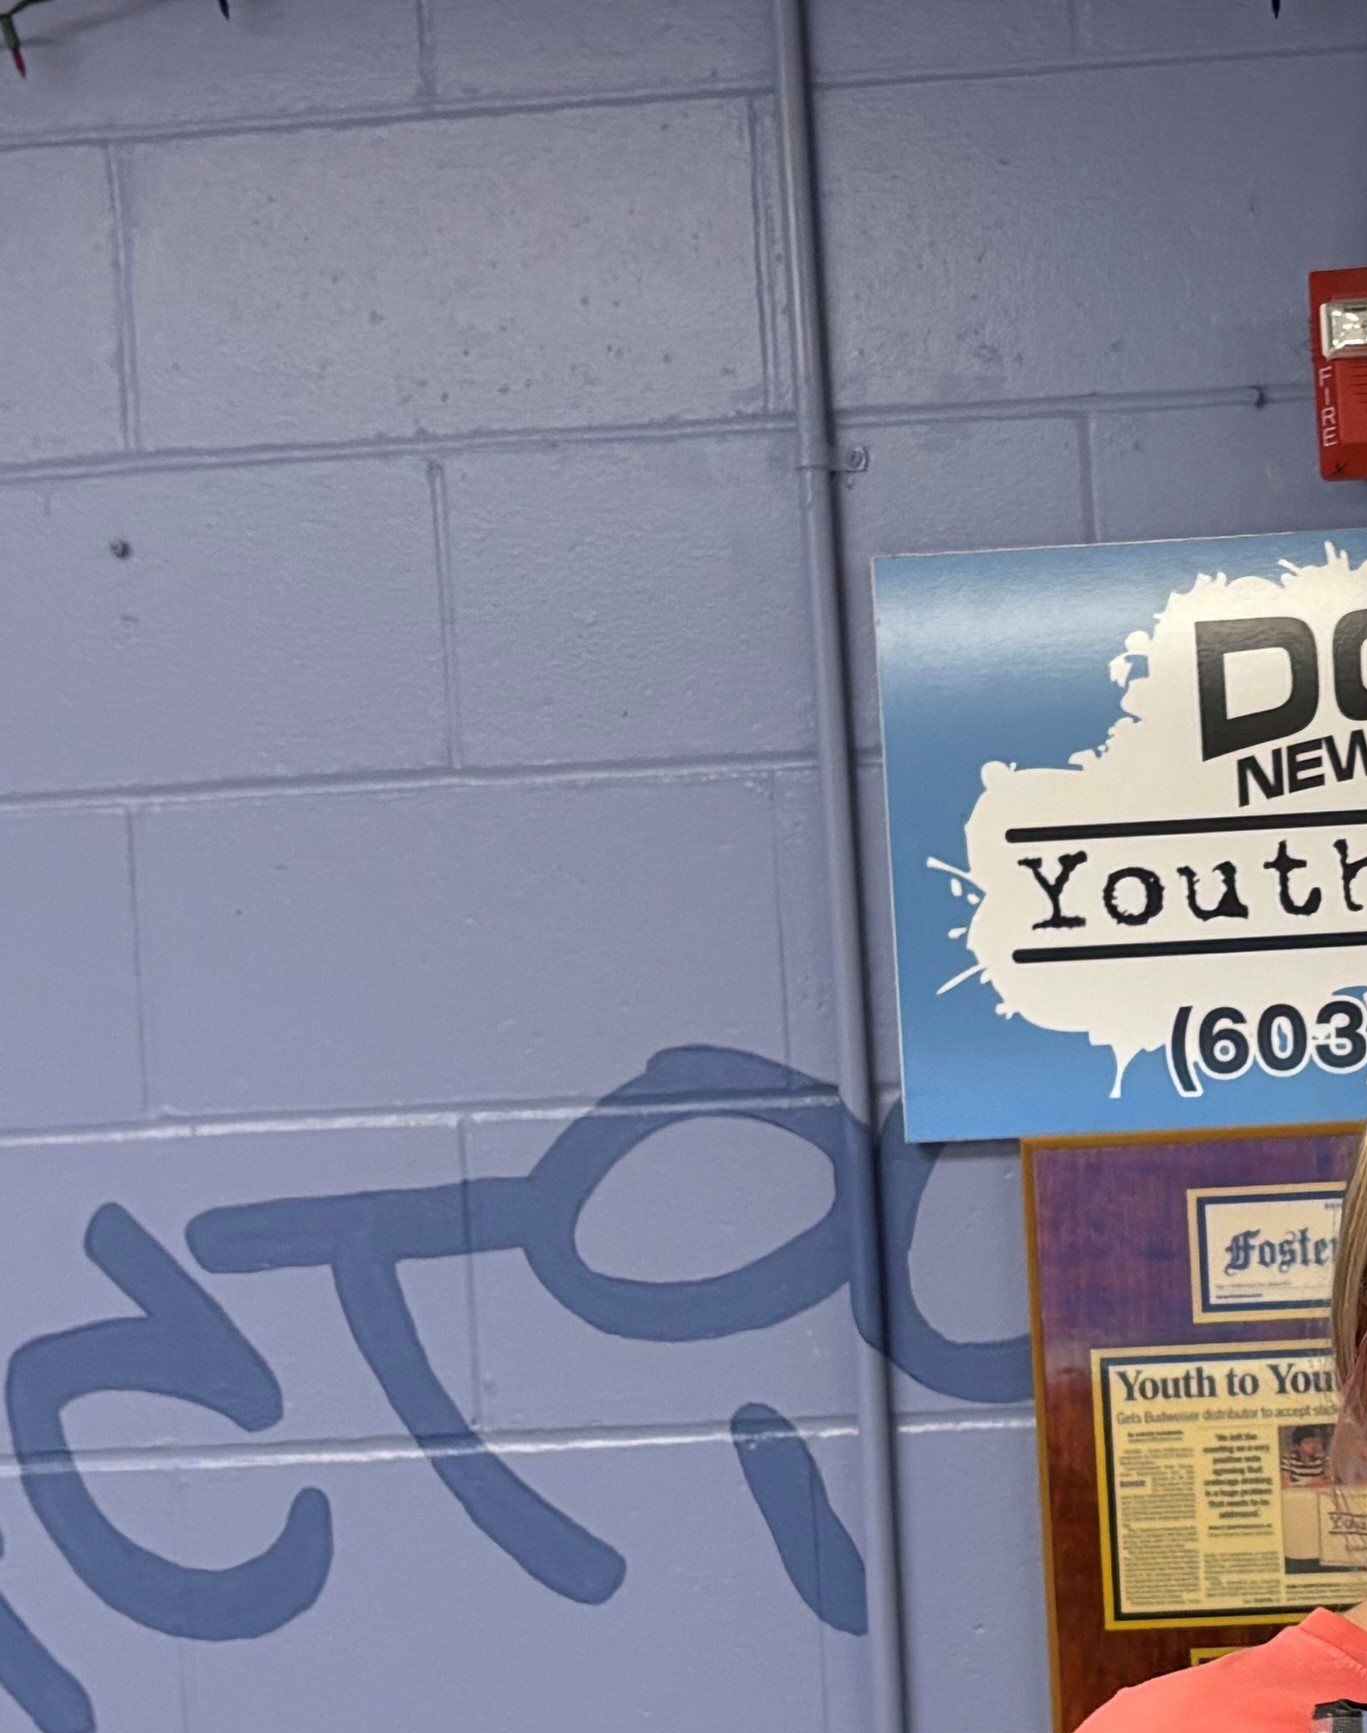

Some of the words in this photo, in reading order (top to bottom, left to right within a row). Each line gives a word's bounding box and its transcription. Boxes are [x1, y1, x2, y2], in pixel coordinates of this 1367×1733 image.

[1319, 366, 1337, 447] FIRE
[1224, 1227, 1342, 1276] Foste
[1116, 1366, 1217, 1401] Youth
[1226, 1367, 1259, 1396] to
[1267, 1362, 1341, 1394] You
